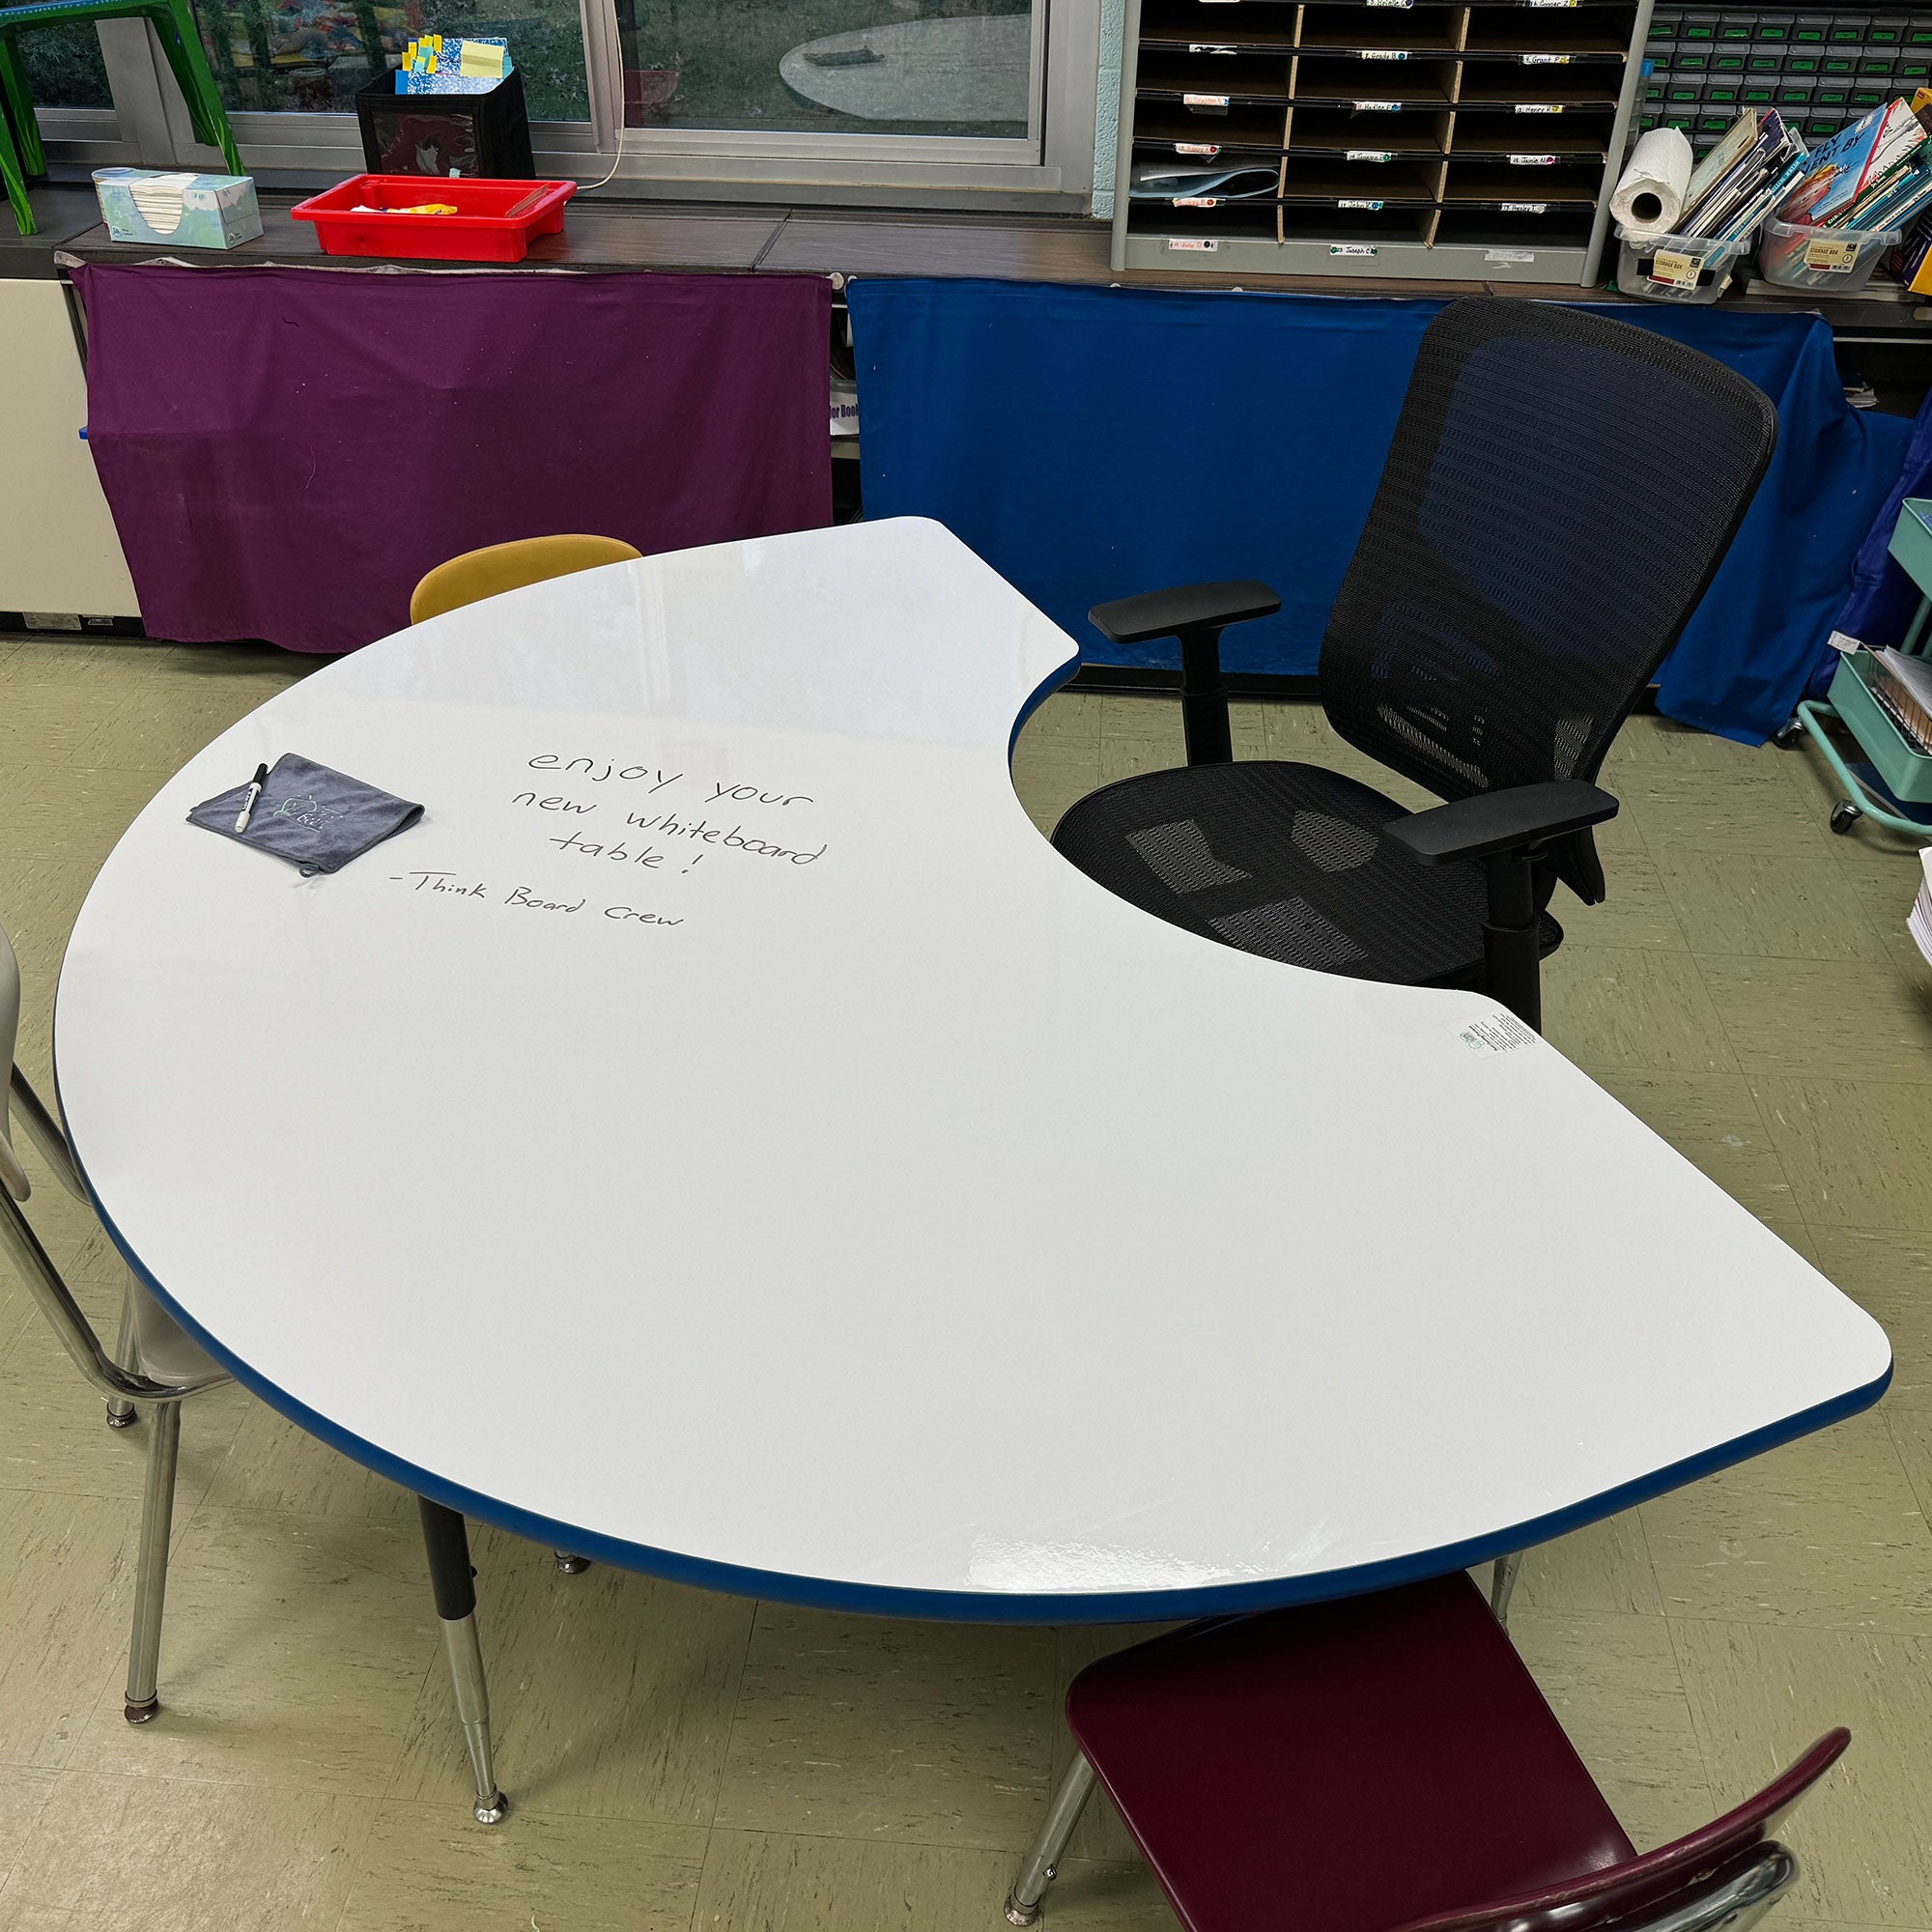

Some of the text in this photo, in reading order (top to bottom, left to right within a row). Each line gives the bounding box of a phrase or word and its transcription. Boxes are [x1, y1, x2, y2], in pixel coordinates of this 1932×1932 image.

[1532, 55, 1551, 64] Grant
[1814, 132, 1842, 157] FLY
[1840, 131, 1866, 154] BY
[1346, 245, 1364, 254] Joseph
[1673, 262, 1683, 270] BOX
[528, 753, 814, 808] enjoy your
[511, 789, 828, 867] new whiteboard
[503, 886, 586, 916] Board
[604, 905, 685, 927] Crew
